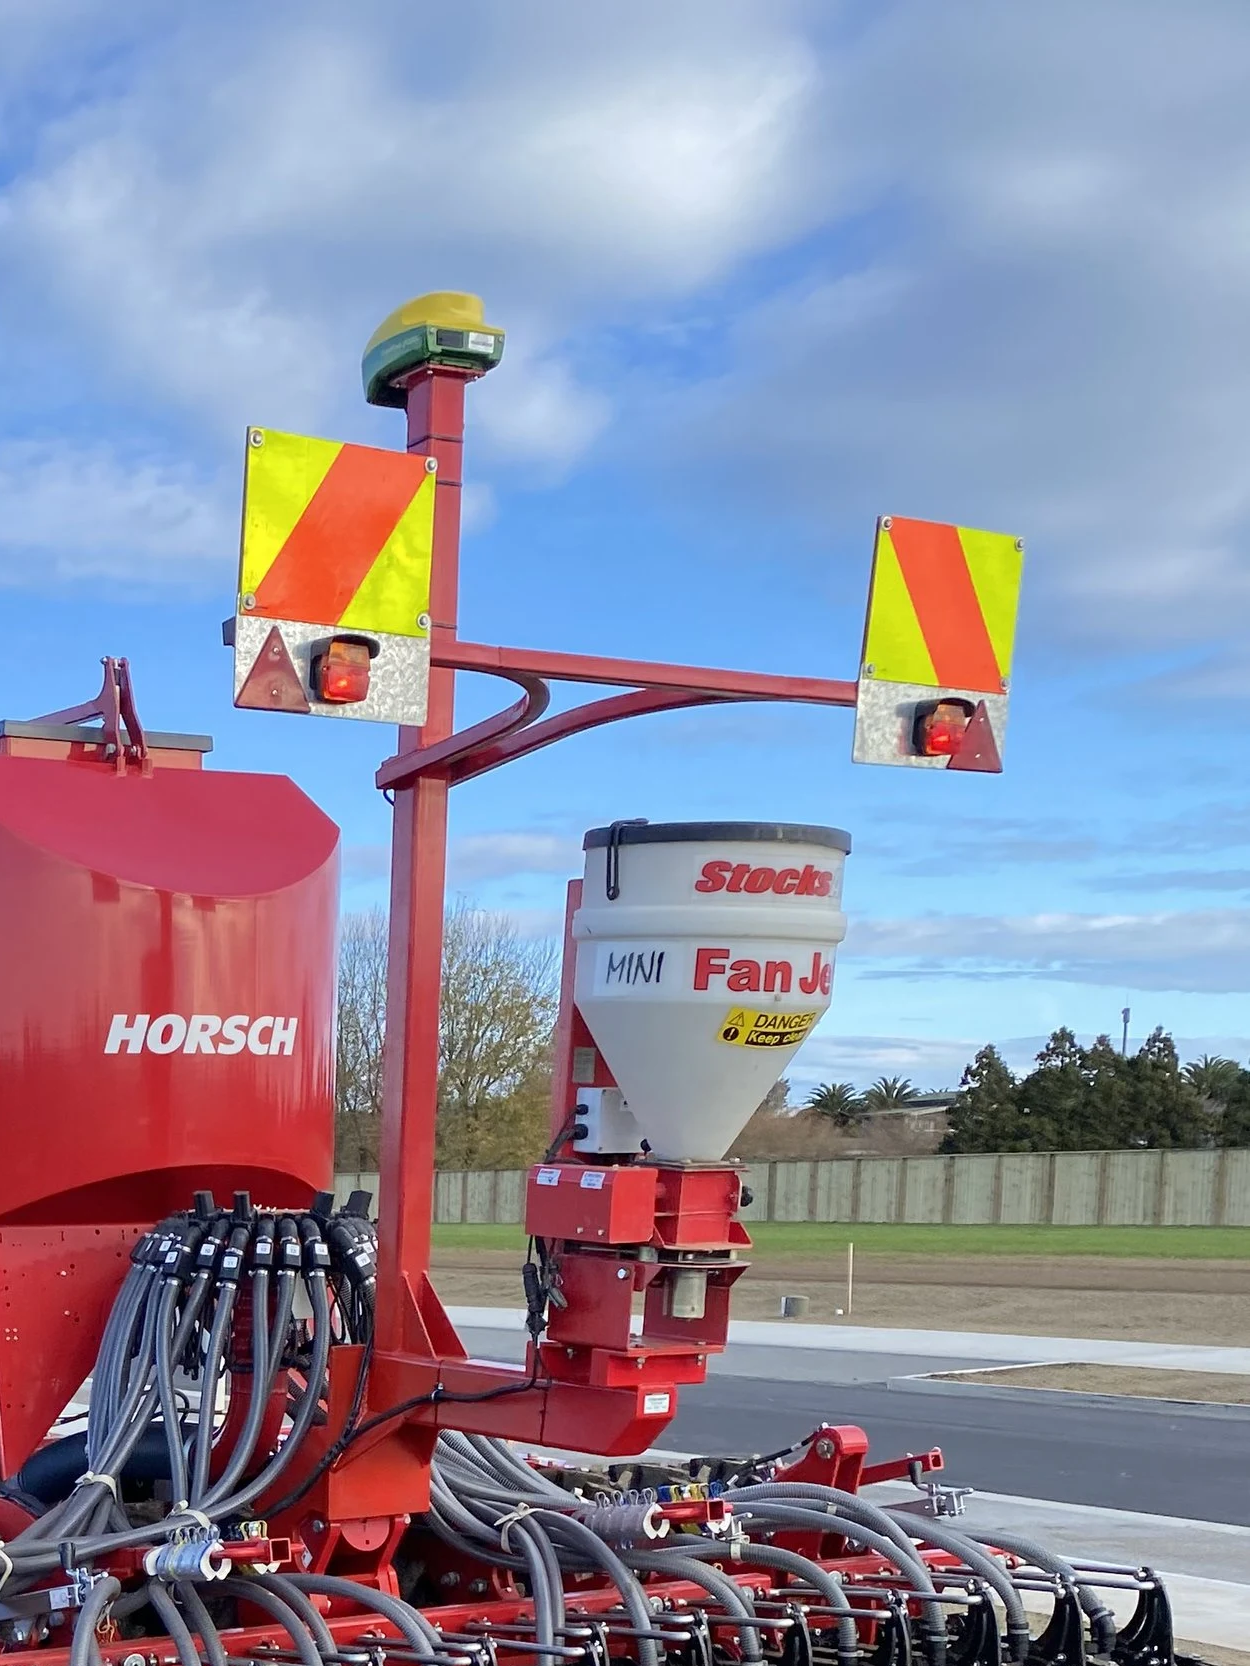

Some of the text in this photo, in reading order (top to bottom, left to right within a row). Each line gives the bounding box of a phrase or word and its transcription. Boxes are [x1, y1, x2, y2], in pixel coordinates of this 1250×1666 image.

[695, 861, 833, 897] Stocks
[606, 950, 665, 985] MINI
[693, 948, 792, 993] Fan
[103, 1014, 298, 1056] HORSCH
[747, 1030, 781, 1046] Keep
[753, 1012, 817, 1030] DANGER
